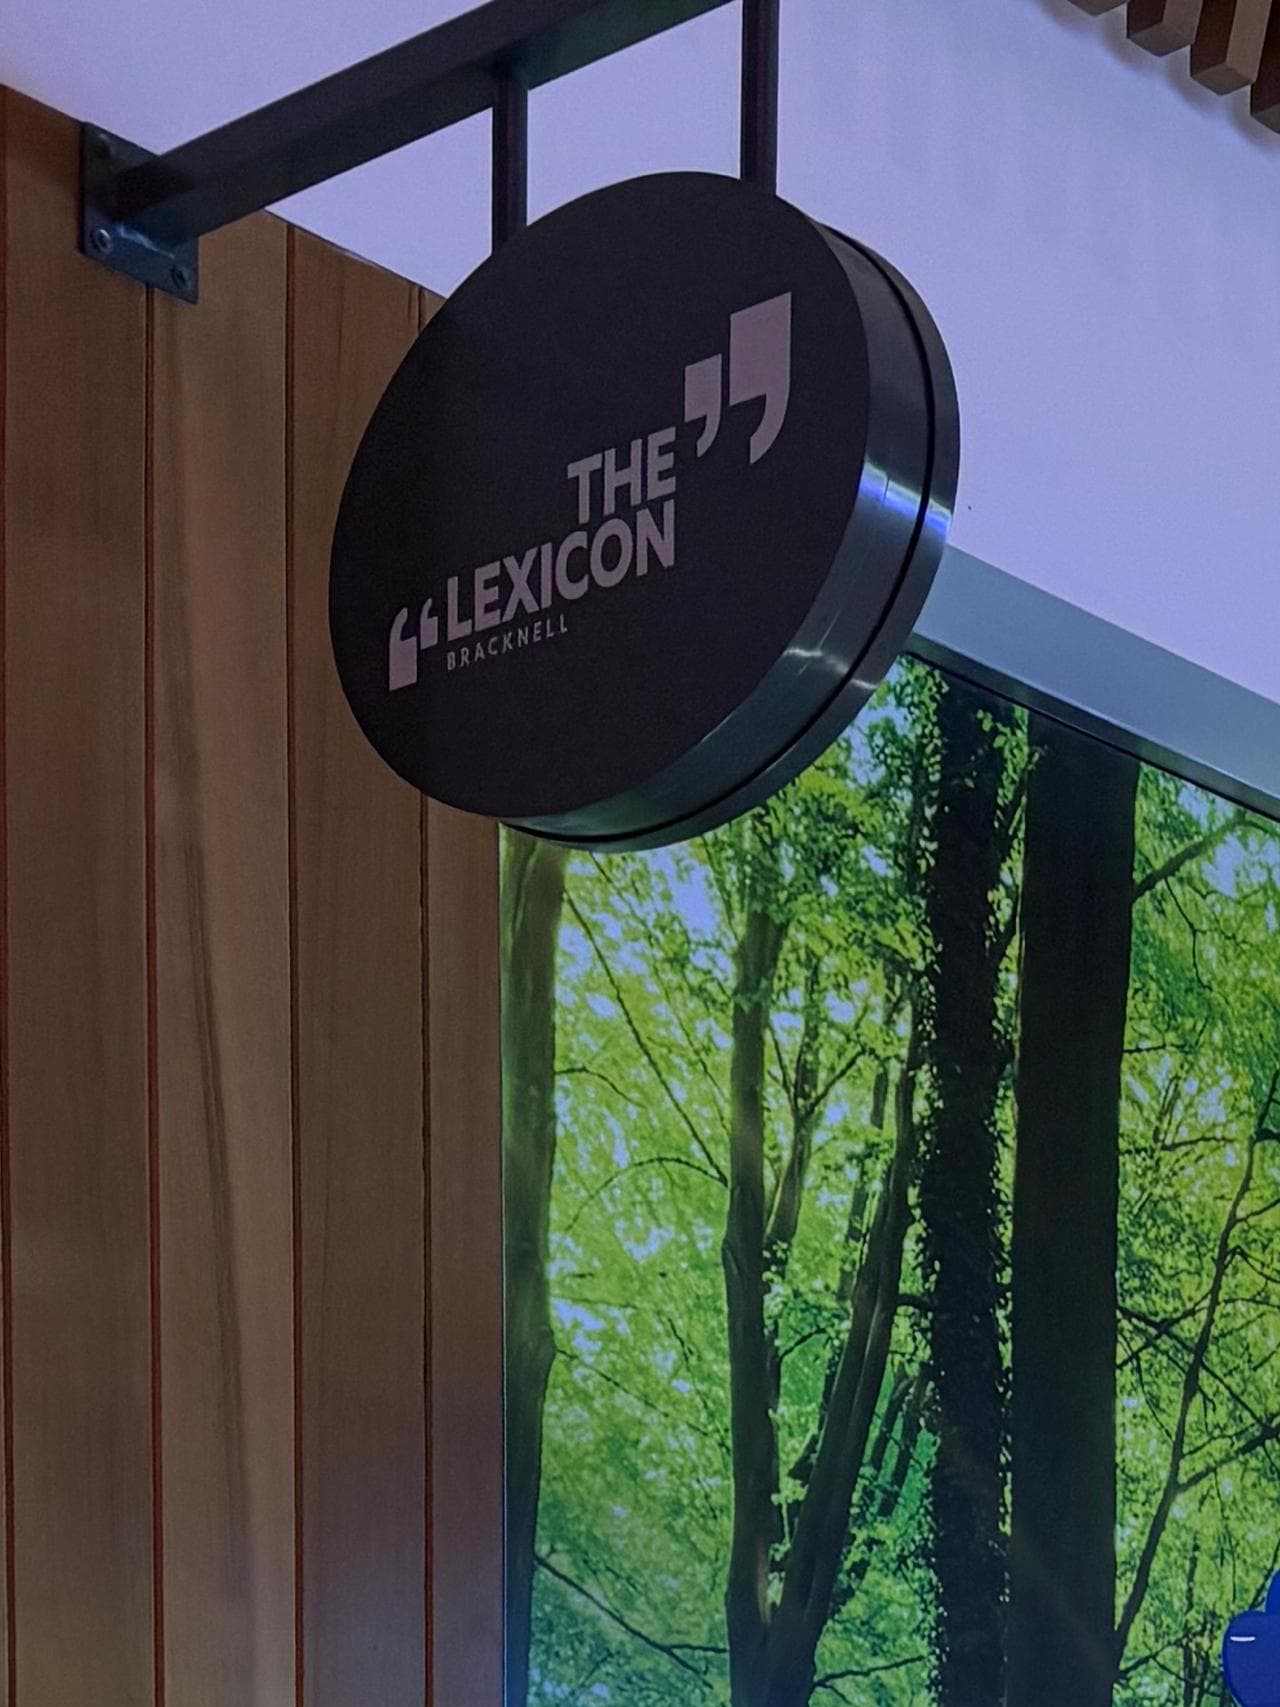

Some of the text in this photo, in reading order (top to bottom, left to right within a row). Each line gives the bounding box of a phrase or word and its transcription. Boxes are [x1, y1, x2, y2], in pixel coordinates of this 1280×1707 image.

[568, 427, 677, 523] THE
[446, 503, 675, 641] LEXICON
[447, 614, 568, 670] BRACKNELL
